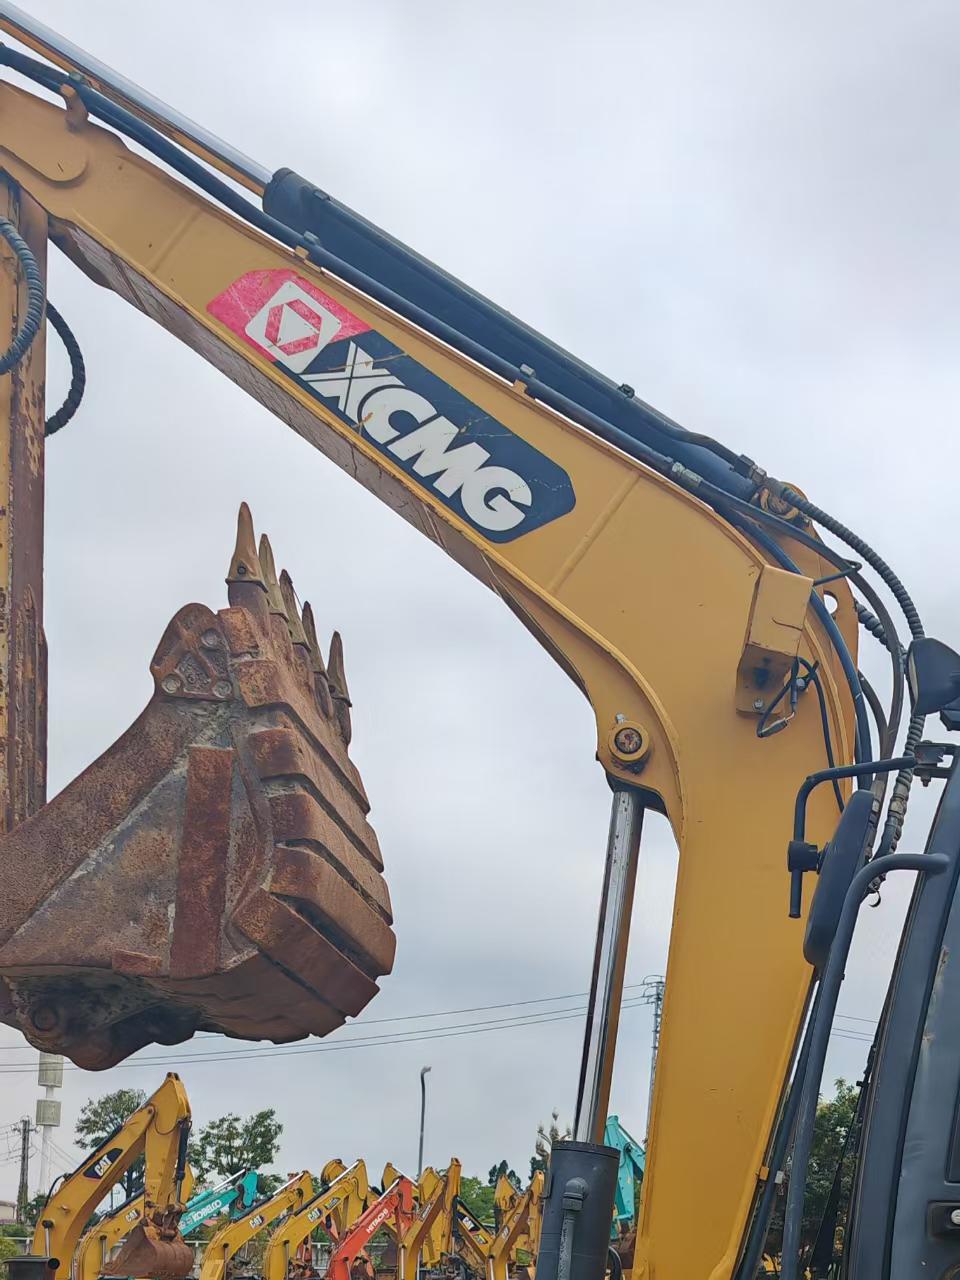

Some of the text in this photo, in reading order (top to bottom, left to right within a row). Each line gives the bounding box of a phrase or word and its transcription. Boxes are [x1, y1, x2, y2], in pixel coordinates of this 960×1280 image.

[300, 341, 532, 532] XCMG
[94, 1155, 112, 1178] CAT
[125, 1209, 138, 1223] CAT
[192, 1200, 222, 1222] KOBELCO
[249, 1215, 262, 1228] CAT
[308, 1208, 320, 1222] CAT
[366, 1208, 389, 1234] HITACHI
